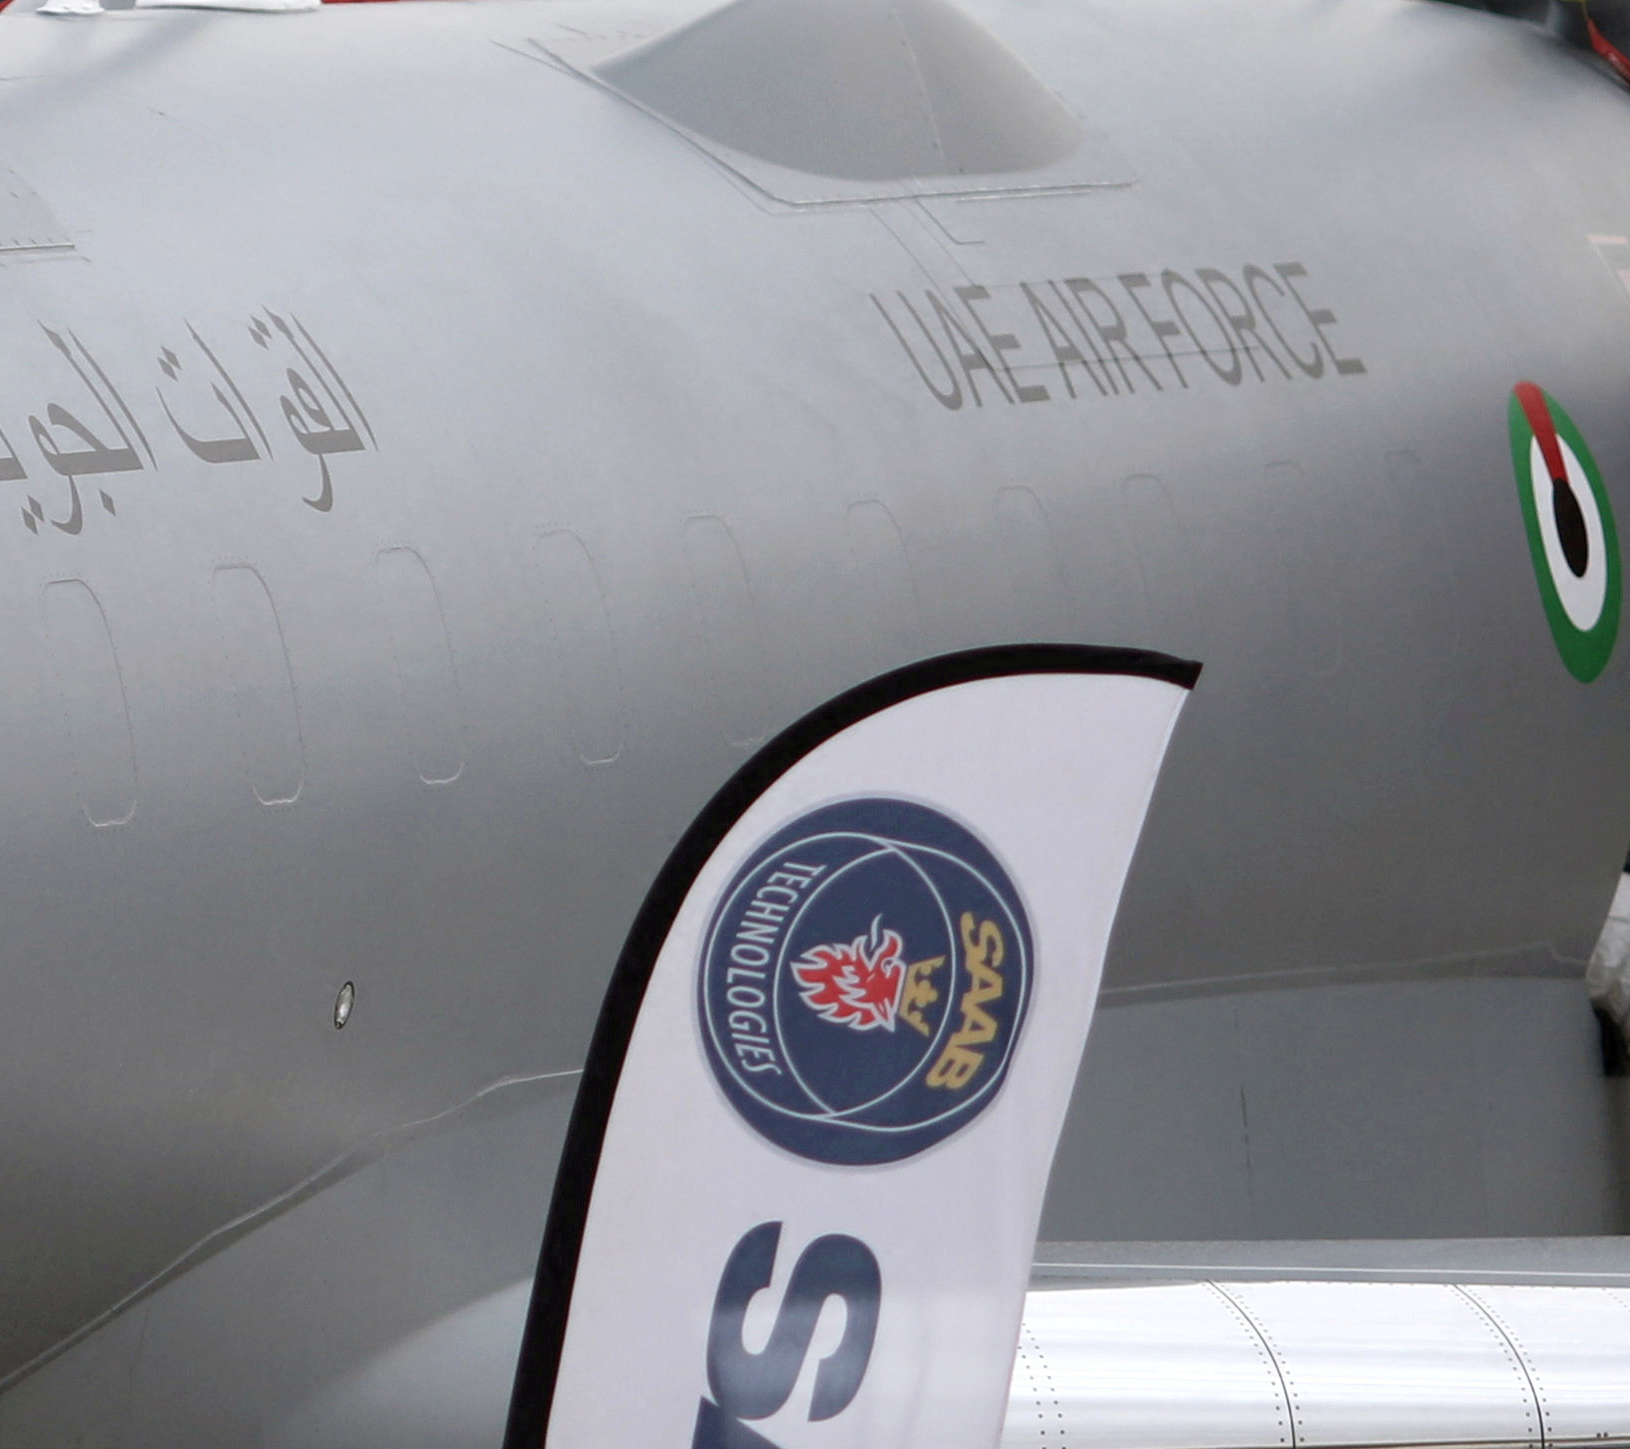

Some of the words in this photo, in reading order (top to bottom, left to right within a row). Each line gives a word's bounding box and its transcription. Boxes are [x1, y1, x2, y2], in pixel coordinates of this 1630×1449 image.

[156, 304, 378, 512] القوات
[869, 286, 1052, 410] UAE
[1019, 277, 1149, 399] AIR
[1118, 263, 1367, 388] FORCE
[728, 860, 828, 1079] TECHNOLOGIES
[925, 911, 1003, 1092] SAAB
